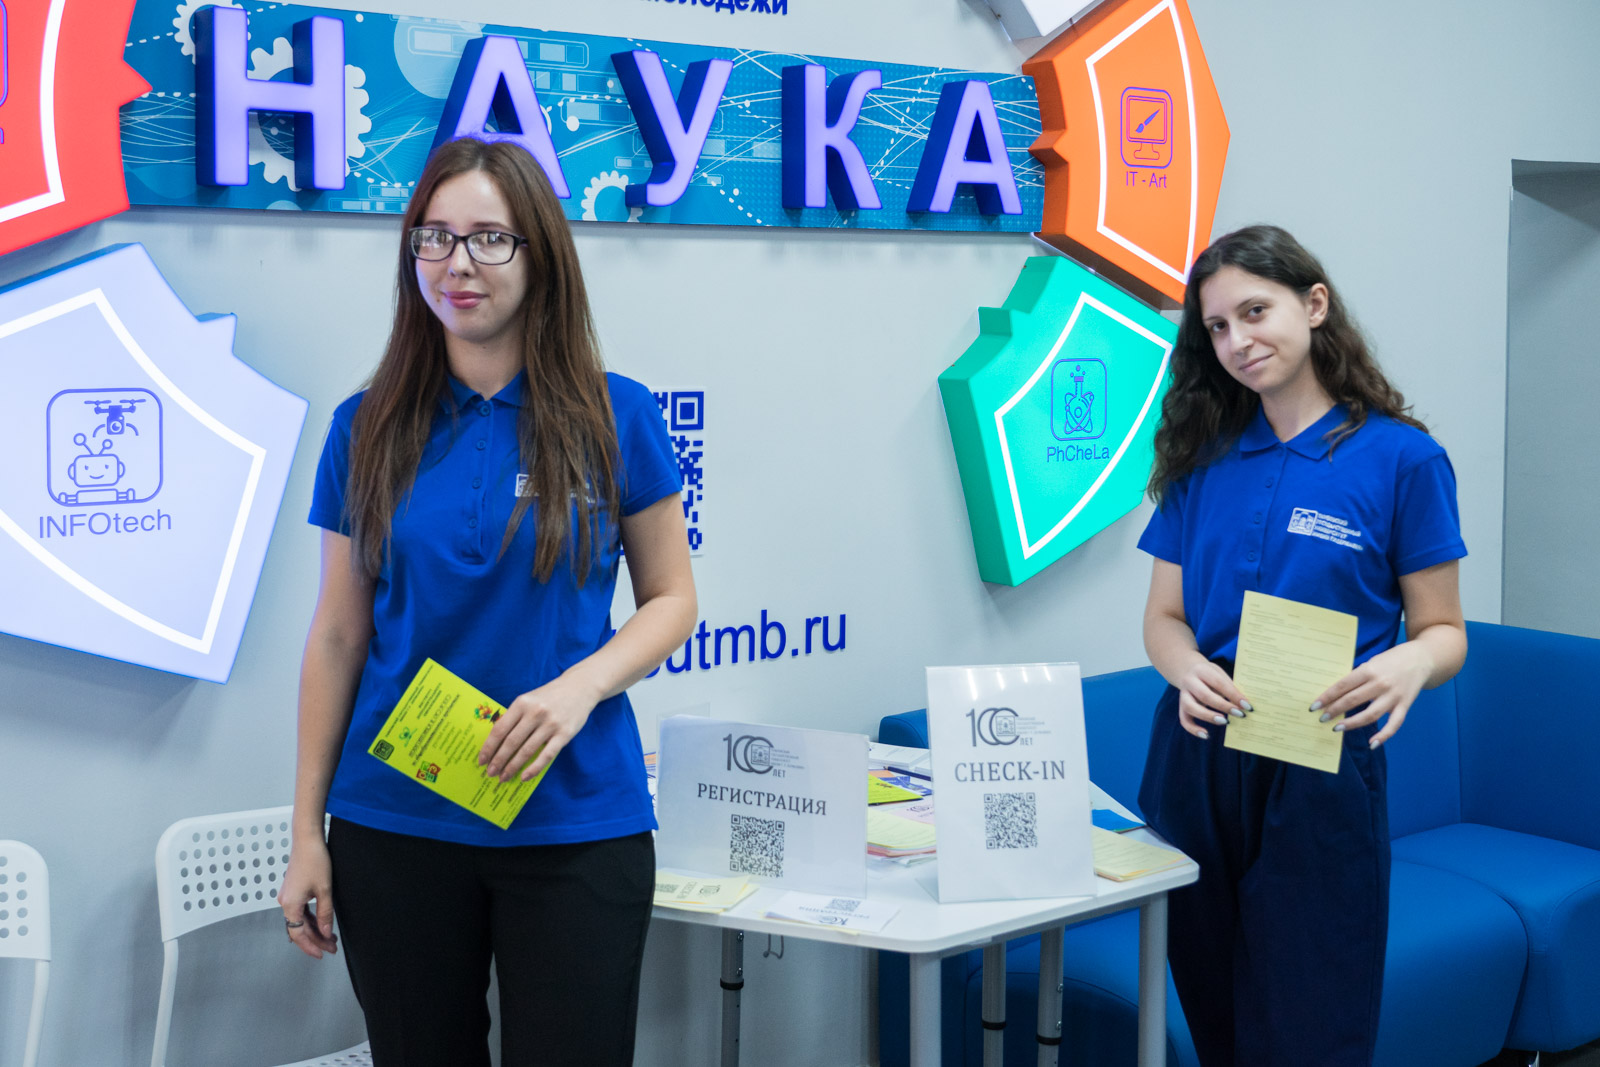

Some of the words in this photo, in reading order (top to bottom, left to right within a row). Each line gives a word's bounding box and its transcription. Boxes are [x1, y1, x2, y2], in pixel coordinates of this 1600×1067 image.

[195, 6, 1023, 215] НАУКА
[1125, 170, 1139, 187] IT
[1148, 172, 1168, 189] Art
[1046, 443, 1110, 463] PhCheLa
[39, 508, 172, 539] INFOtech
[612, 609, 846, 679] utmb.ru
[954, 760, 1065, 783] CHECK-IN
[697, 782, 827, 816] РЕГИСТРАЦИЯ
